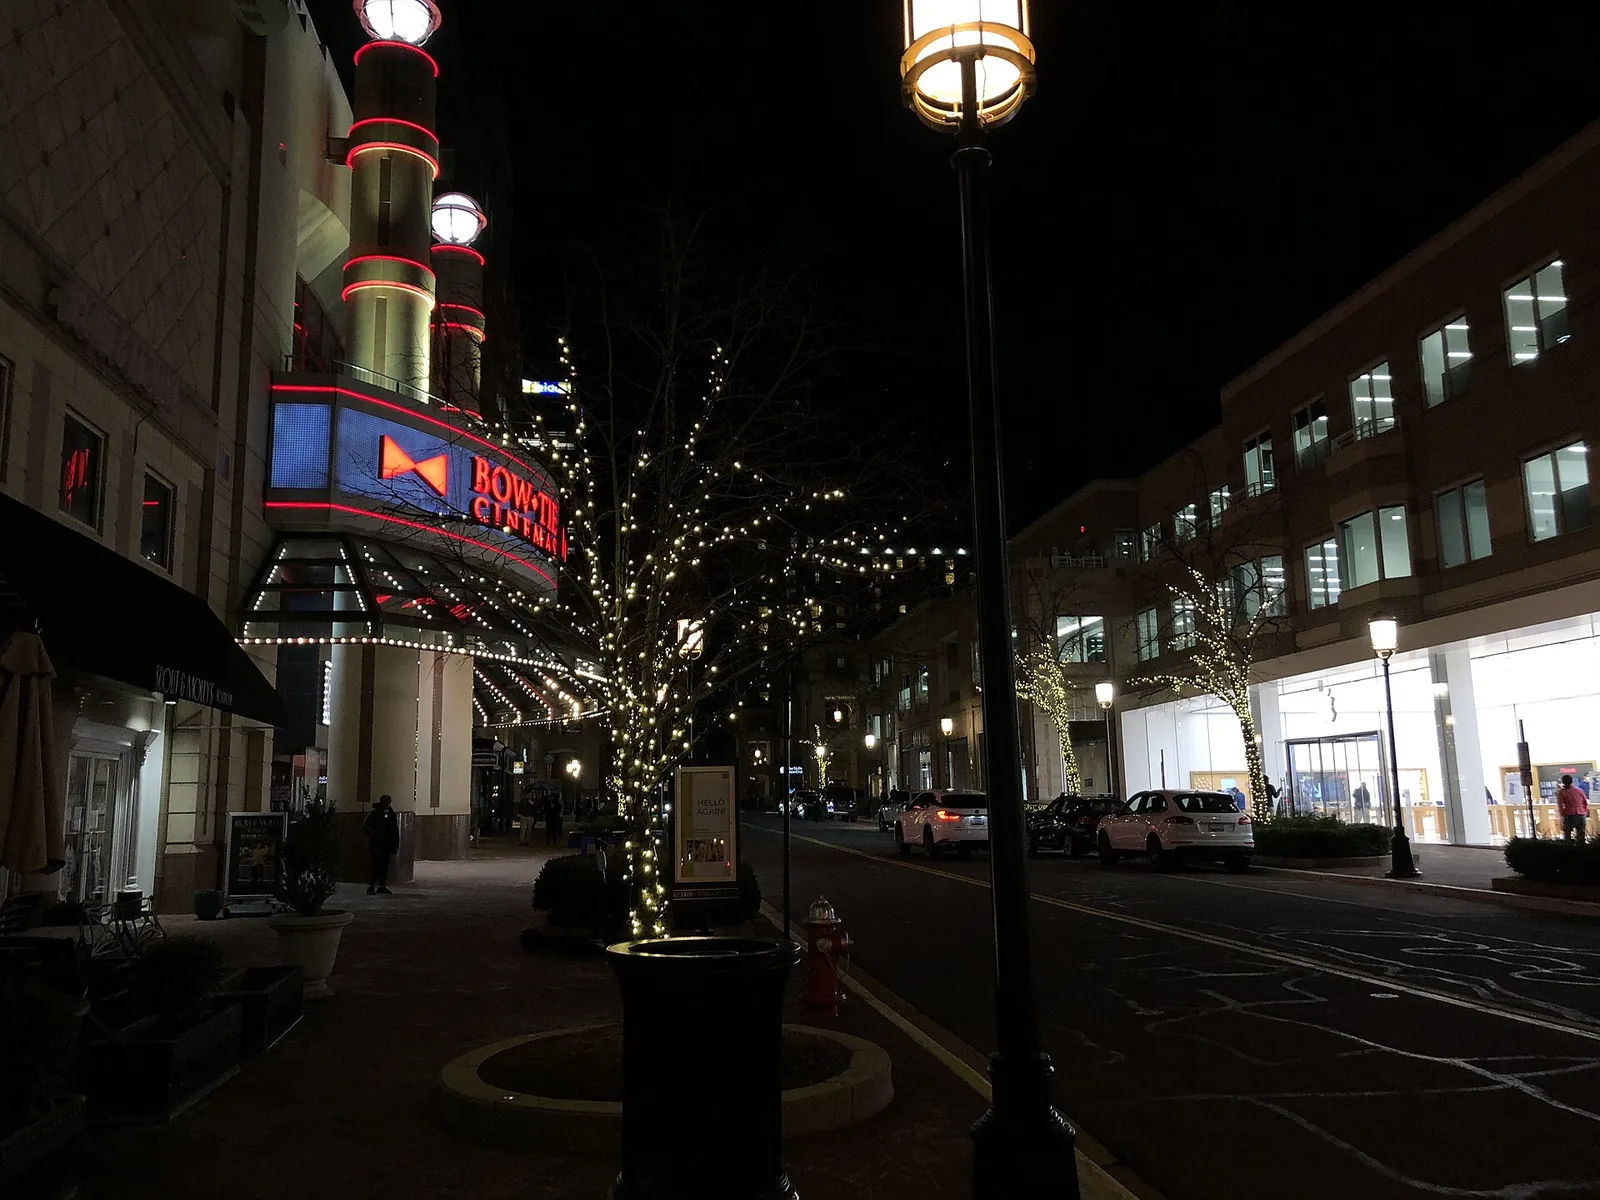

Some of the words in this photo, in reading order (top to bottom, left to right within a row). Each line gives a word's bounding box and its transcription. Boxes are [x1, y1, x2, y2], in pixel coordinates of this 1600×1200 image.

[472, 454, 534, 514] BOW
[473, 496, 558, 559] CINEMAS
[696, 808, 726, 816] AGAIN!
[697, 799, 725, 807] HELLO
